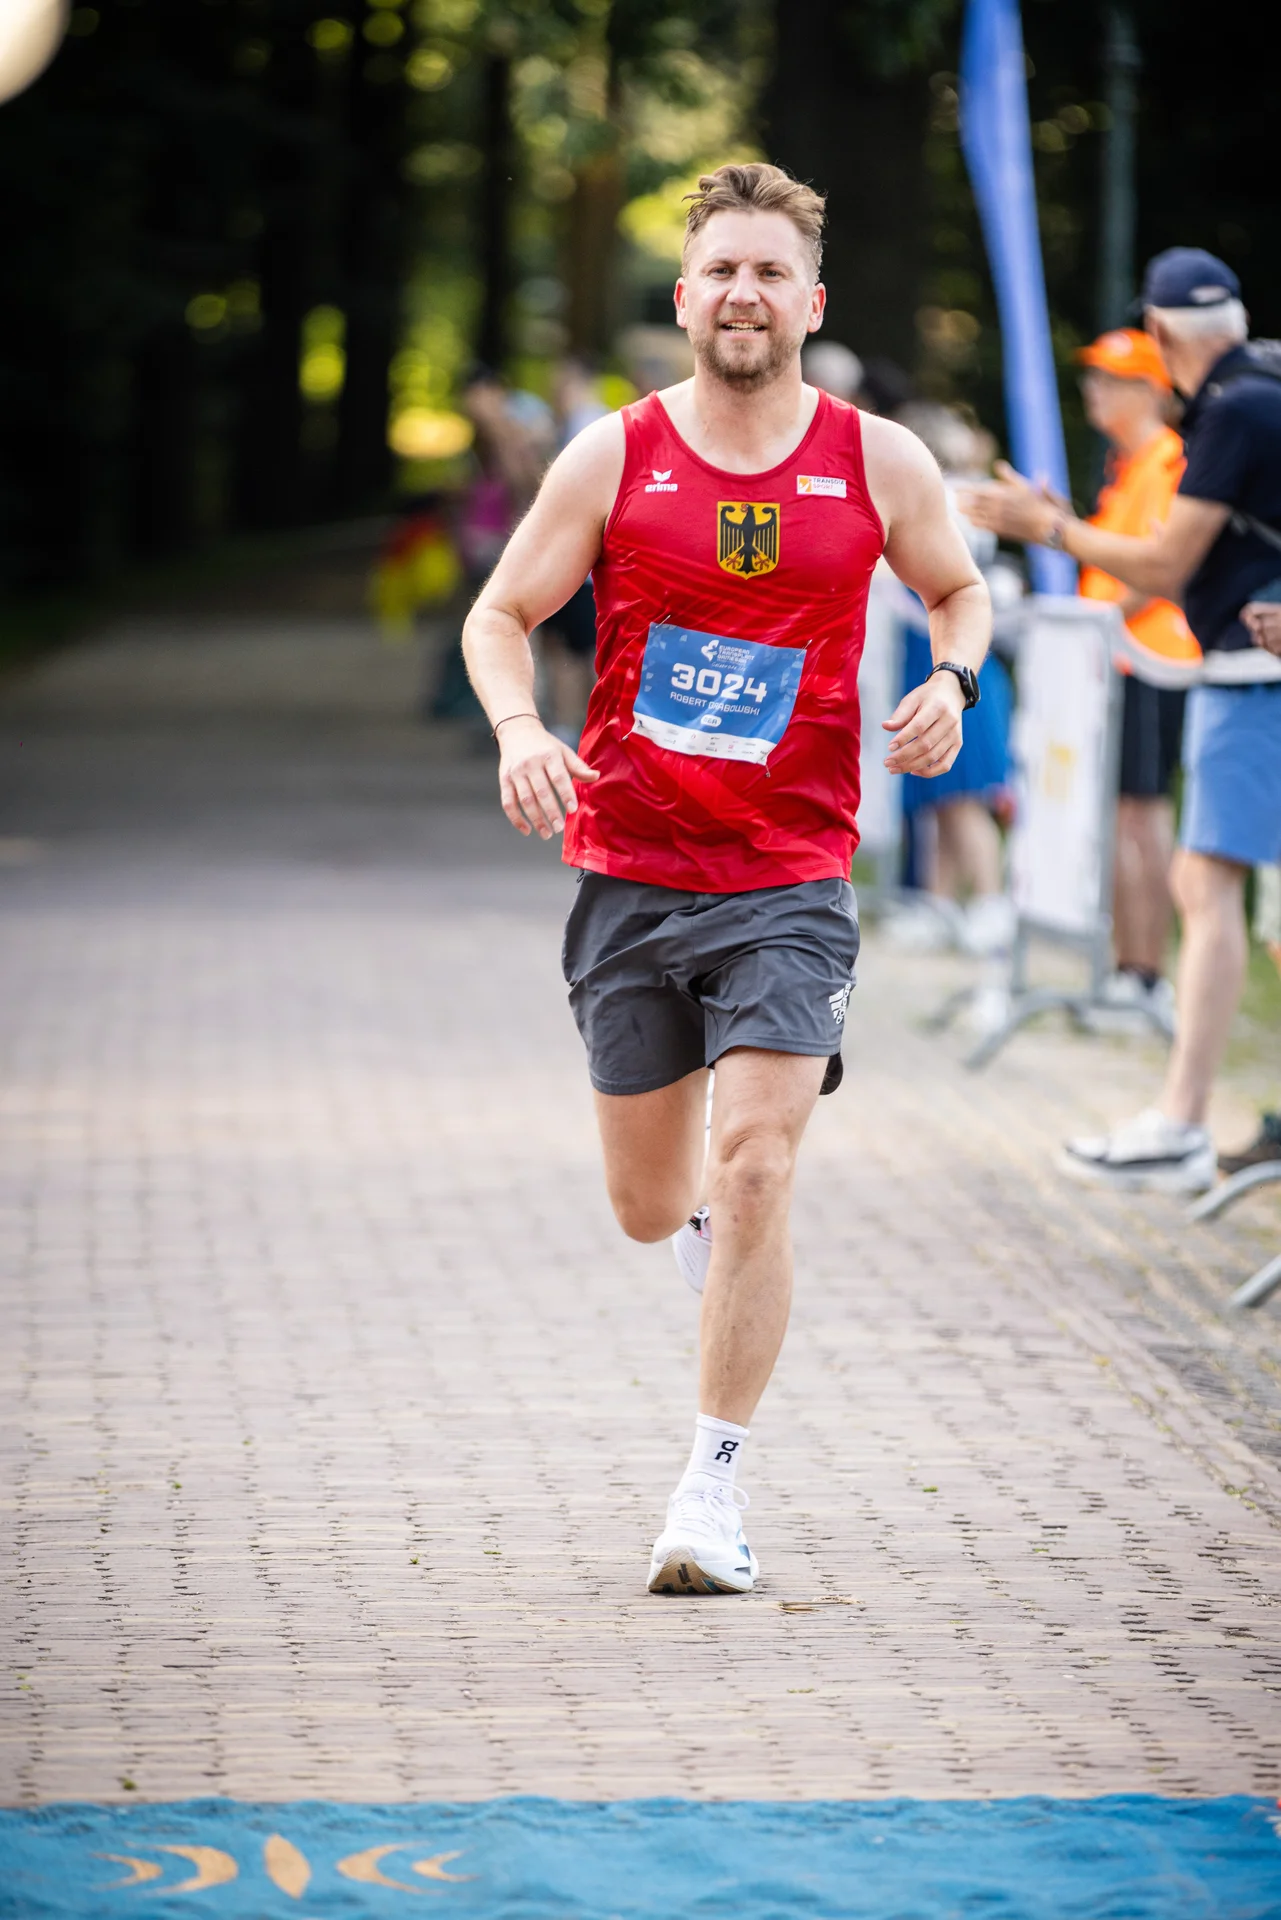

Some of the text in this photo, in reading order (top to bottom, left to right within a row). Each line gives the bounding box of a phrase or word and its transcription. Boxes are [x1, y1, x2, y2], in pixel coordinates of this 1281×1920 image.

[644, 482, 678, 493] erima
[671, 663, 767, 703] 3024
[670, 691, 760, 716] ROBERT GRABOWSKI
